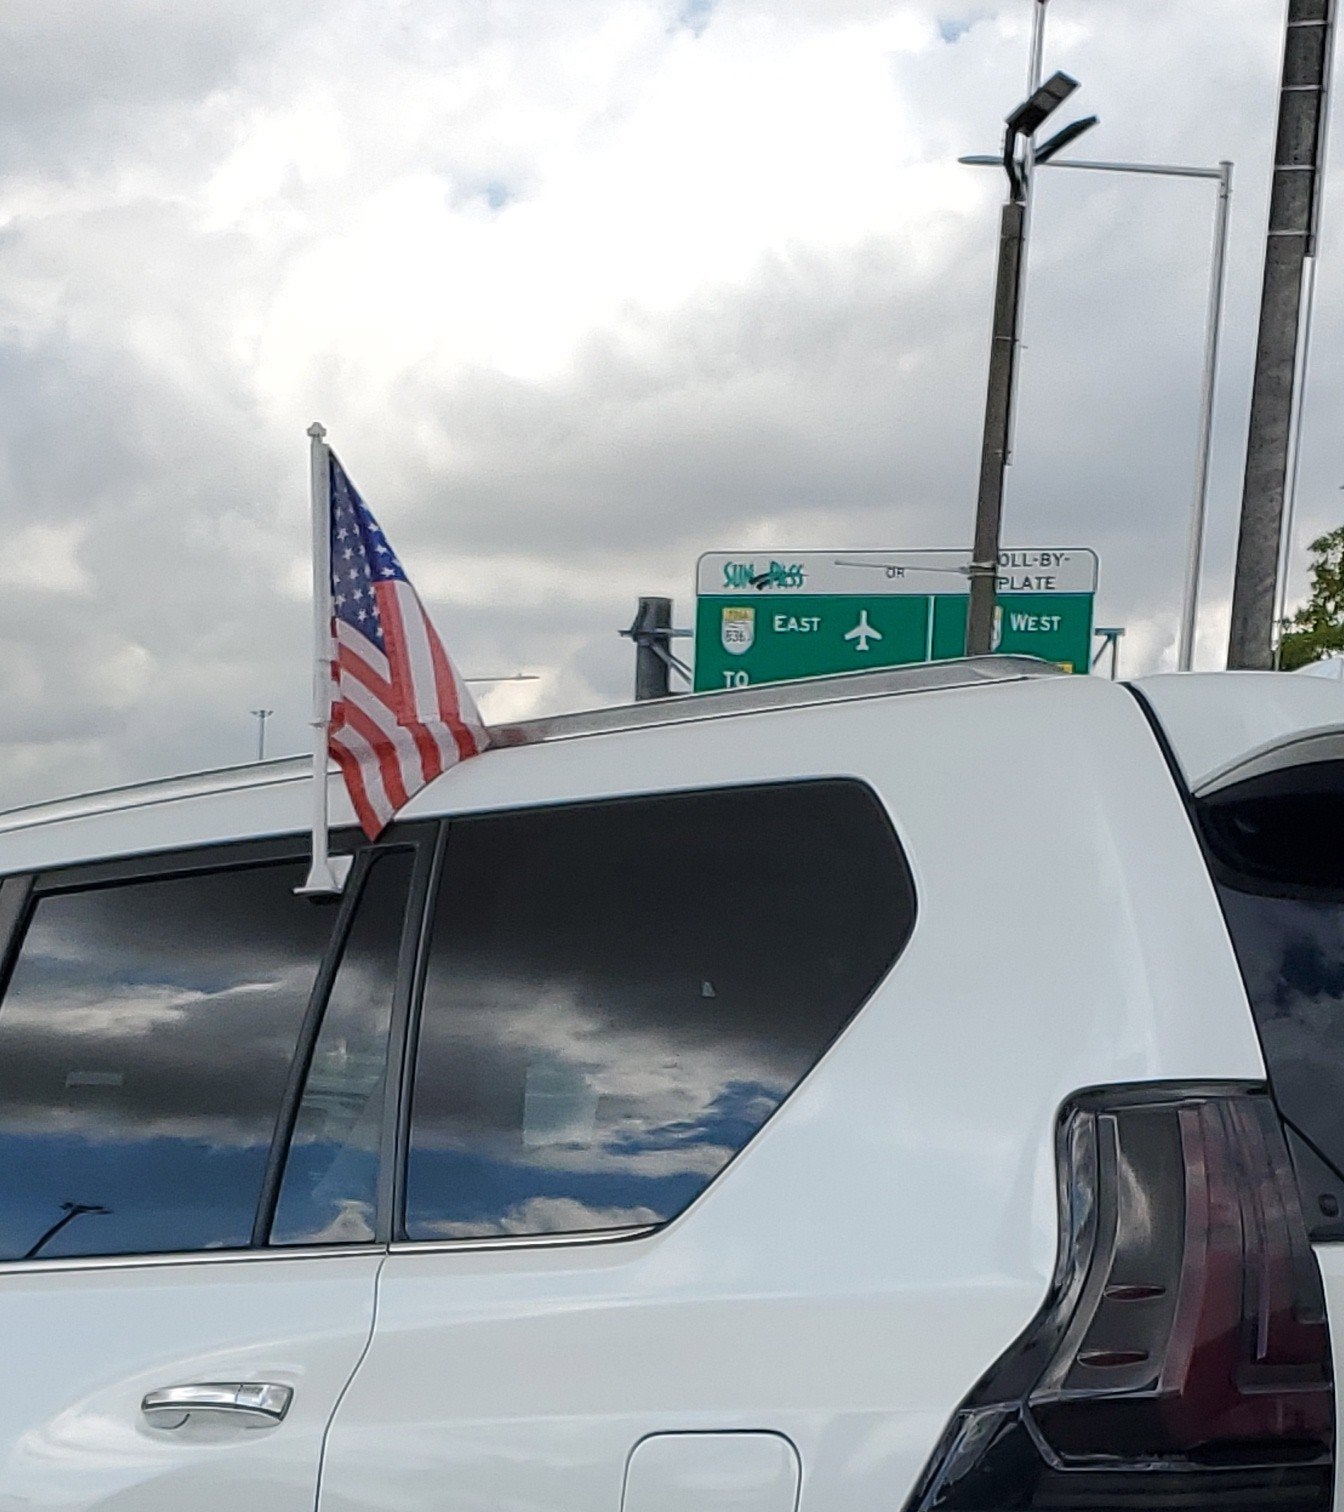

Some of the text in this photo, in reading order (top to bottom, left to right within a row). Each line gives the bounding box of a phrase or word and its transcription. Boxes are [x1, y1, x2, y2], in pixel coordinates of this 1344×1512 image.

[997, 552, 1071, 568] OLL-BY-
[998, 576, 1056, 591] PLATE
[773, 615, 822, 633] EAST
[1009, 612, 1062, 632] WEST
